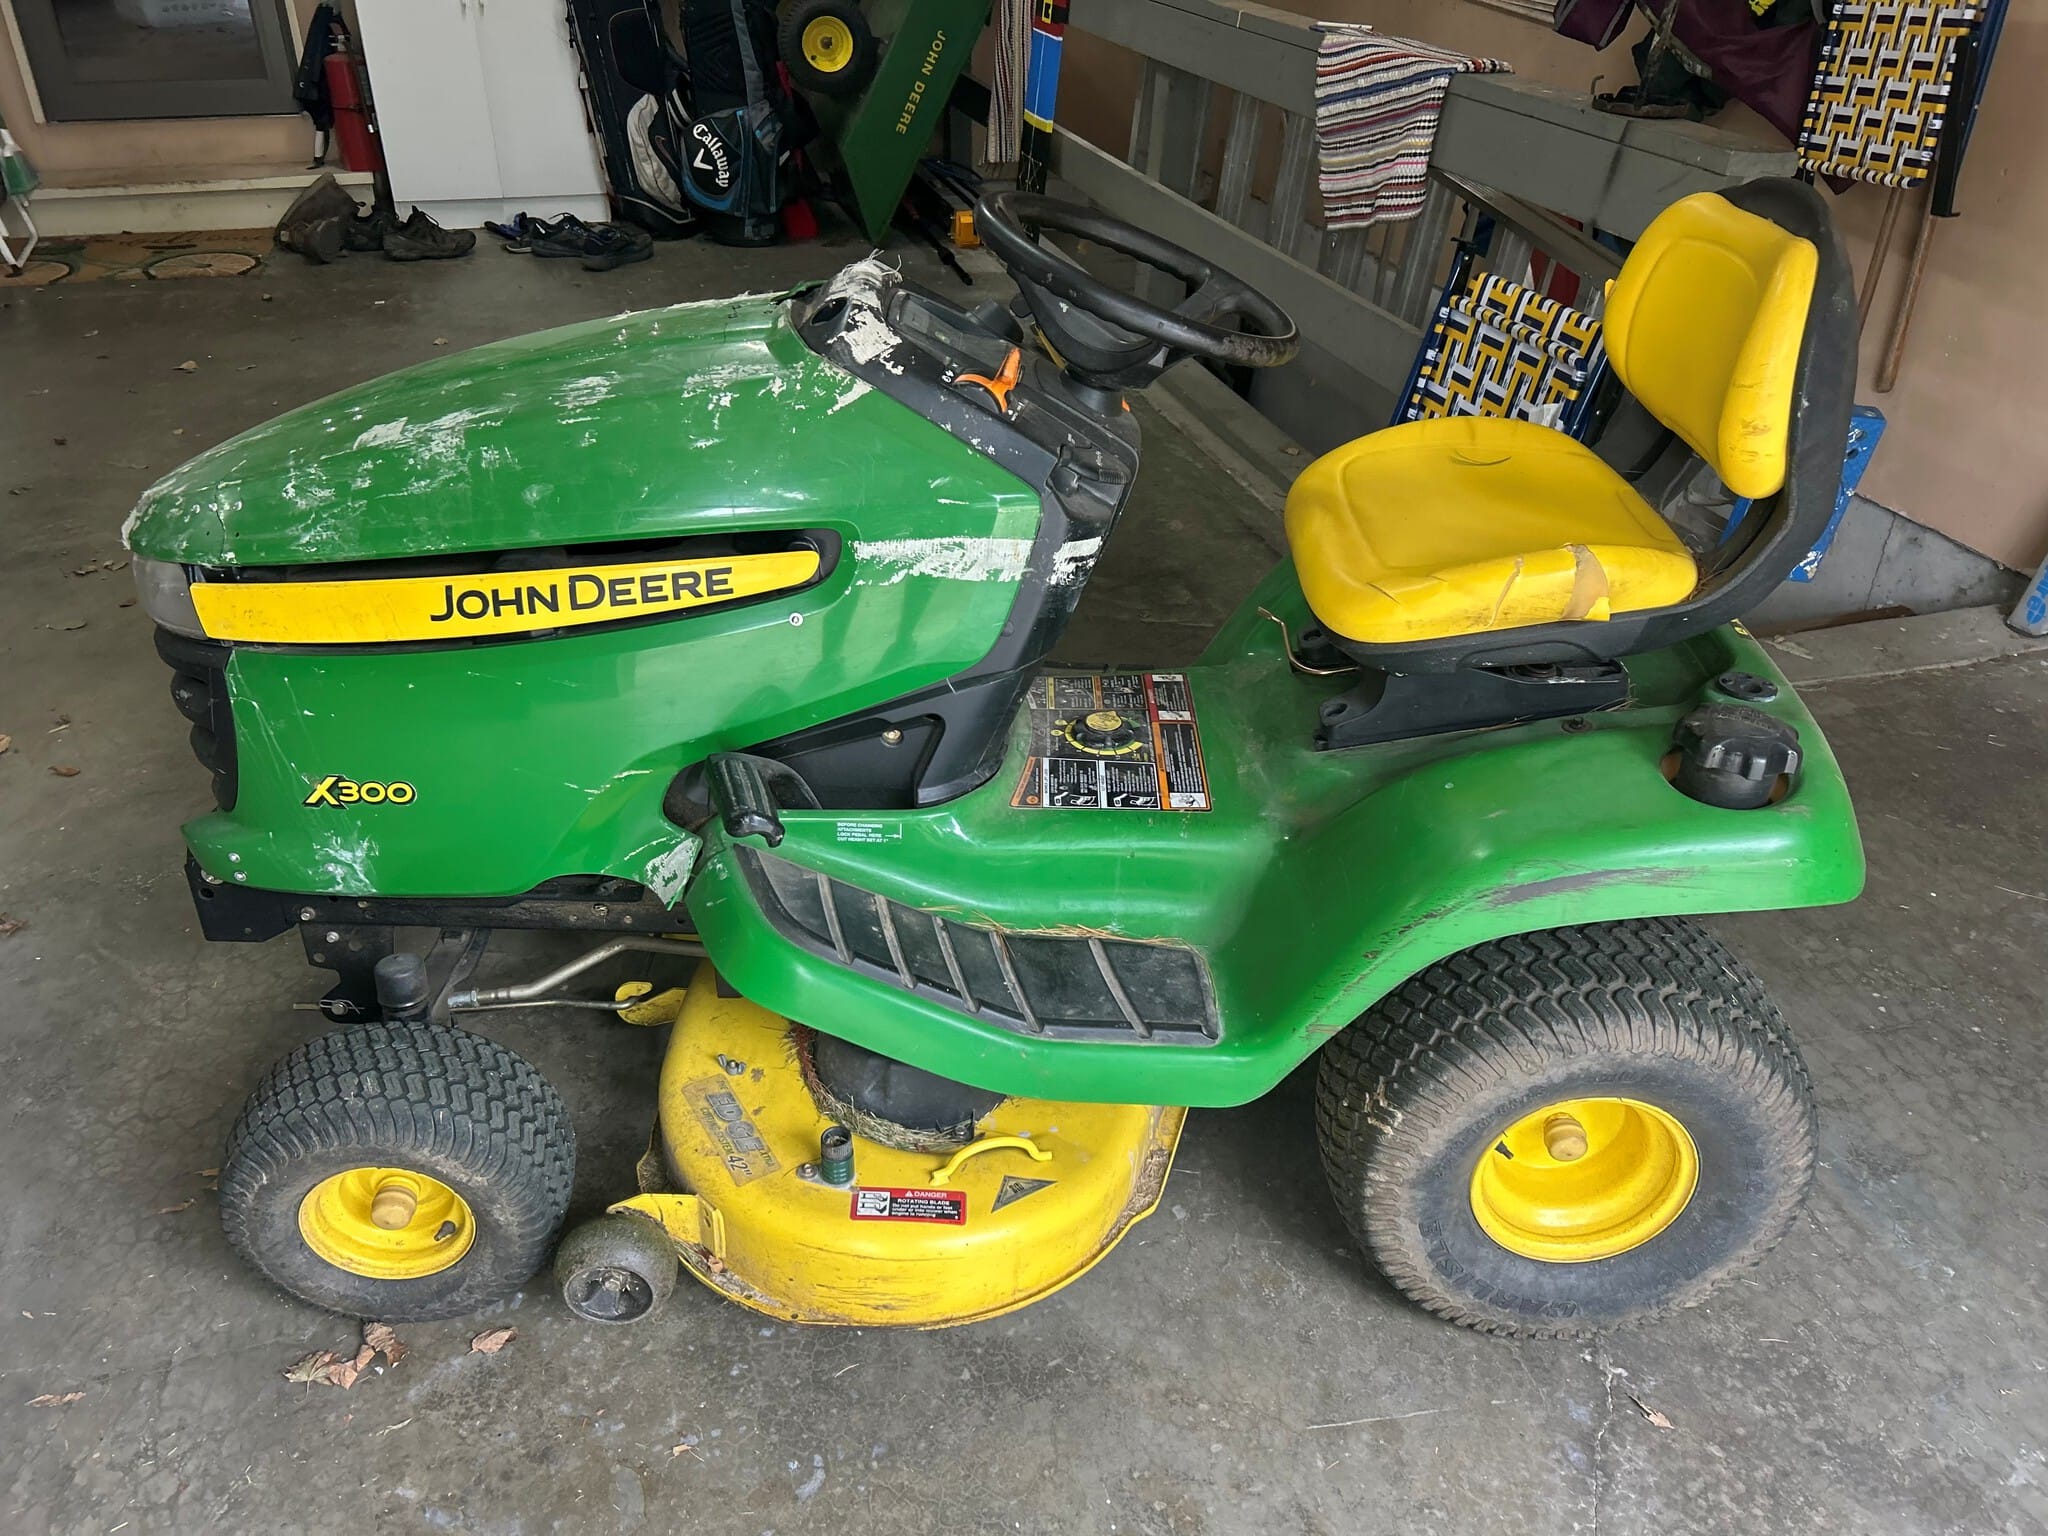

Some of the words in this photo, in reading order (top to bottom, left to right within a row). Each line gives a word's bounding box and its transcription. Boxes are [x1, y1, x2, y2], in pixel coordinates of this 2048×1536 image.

[921, 30, 947, 76] JOHN
[895, 81, 926, 135] DEERE
[692, 123, 730, 188] Callaway
[430, 583, 560, 622] JOHN
[568, 566, 735, 611] DEERE
[304, 775, 414, 807] X300
[705, 1092, 765, 1154] EDGE
[727, 1154, 753, 1176] 42"
